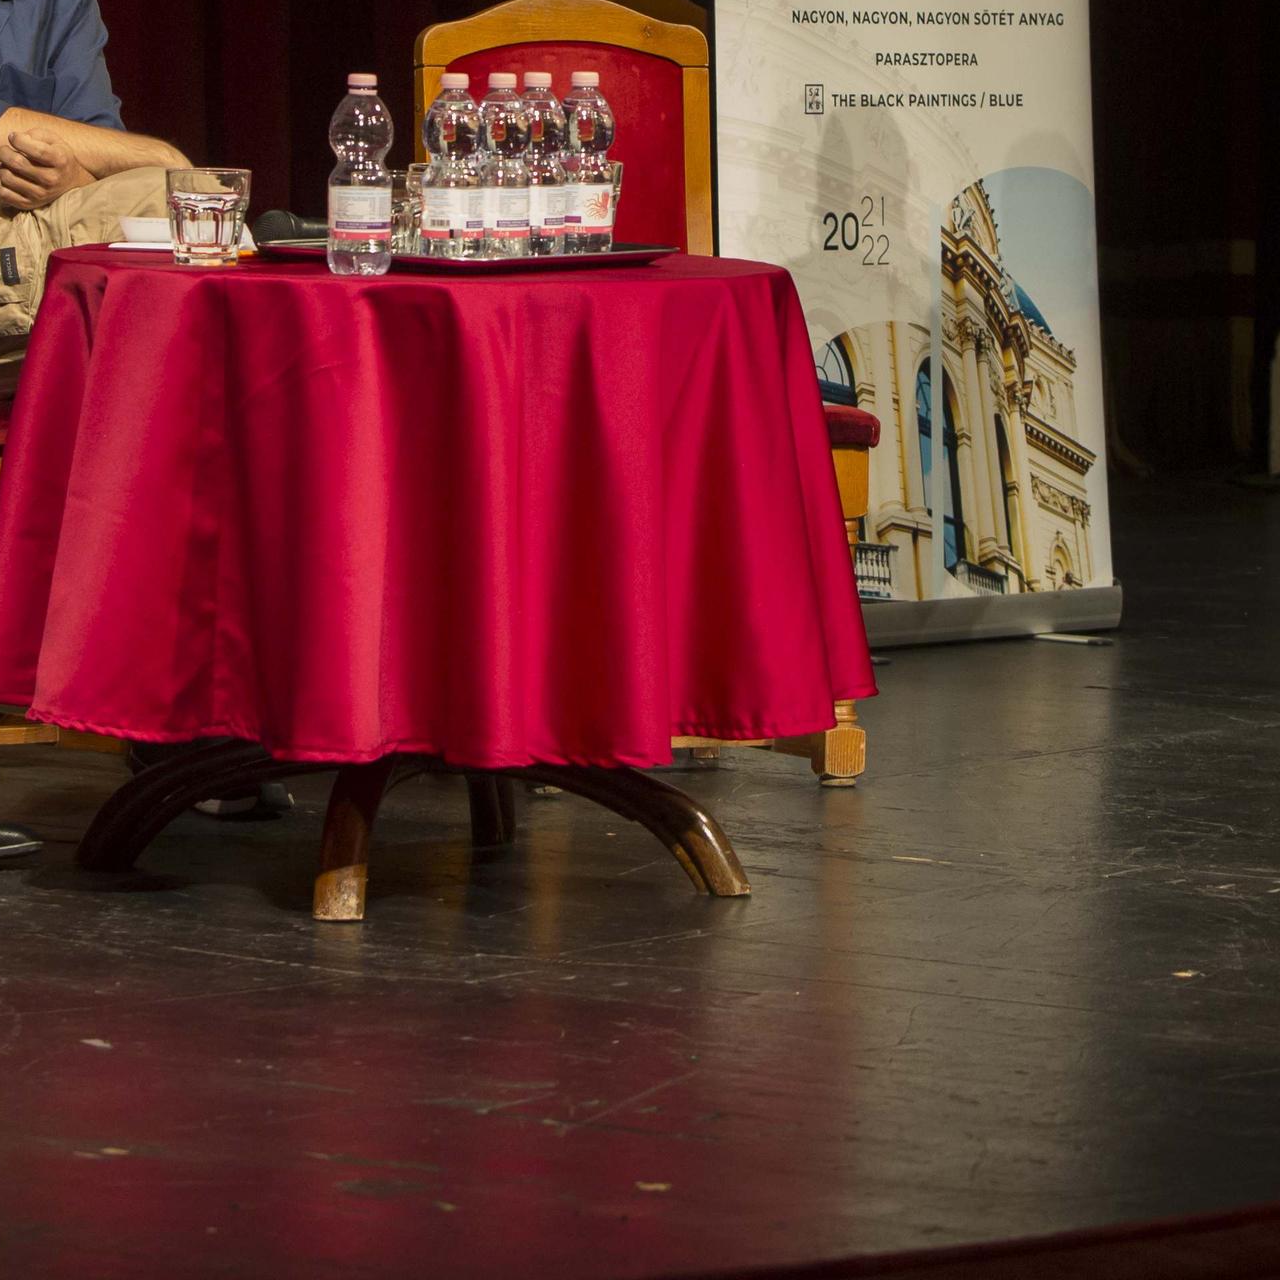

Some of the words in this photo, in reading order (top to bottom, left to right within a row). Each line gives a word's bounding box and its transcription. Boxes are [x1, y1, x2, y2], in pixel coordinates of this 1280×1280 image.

[792, 10, 849, 27] NAGYON,
[852, 10, 912, 27] NAGYON,
[916, 11, 970, 26] NAGYON
[973, 9, 1015, 26] SÖTÉT
[1018, 12, 1064, 27] ANYAG
[875, 52, 979, 67] PARASZTOPERA
[831, 93, 857, 108] THE
[860, 93, 905, 108] BLACK
[908, 93, 977, 108] PAINTINGS
[989, 93, 1024, 107] BLUE
